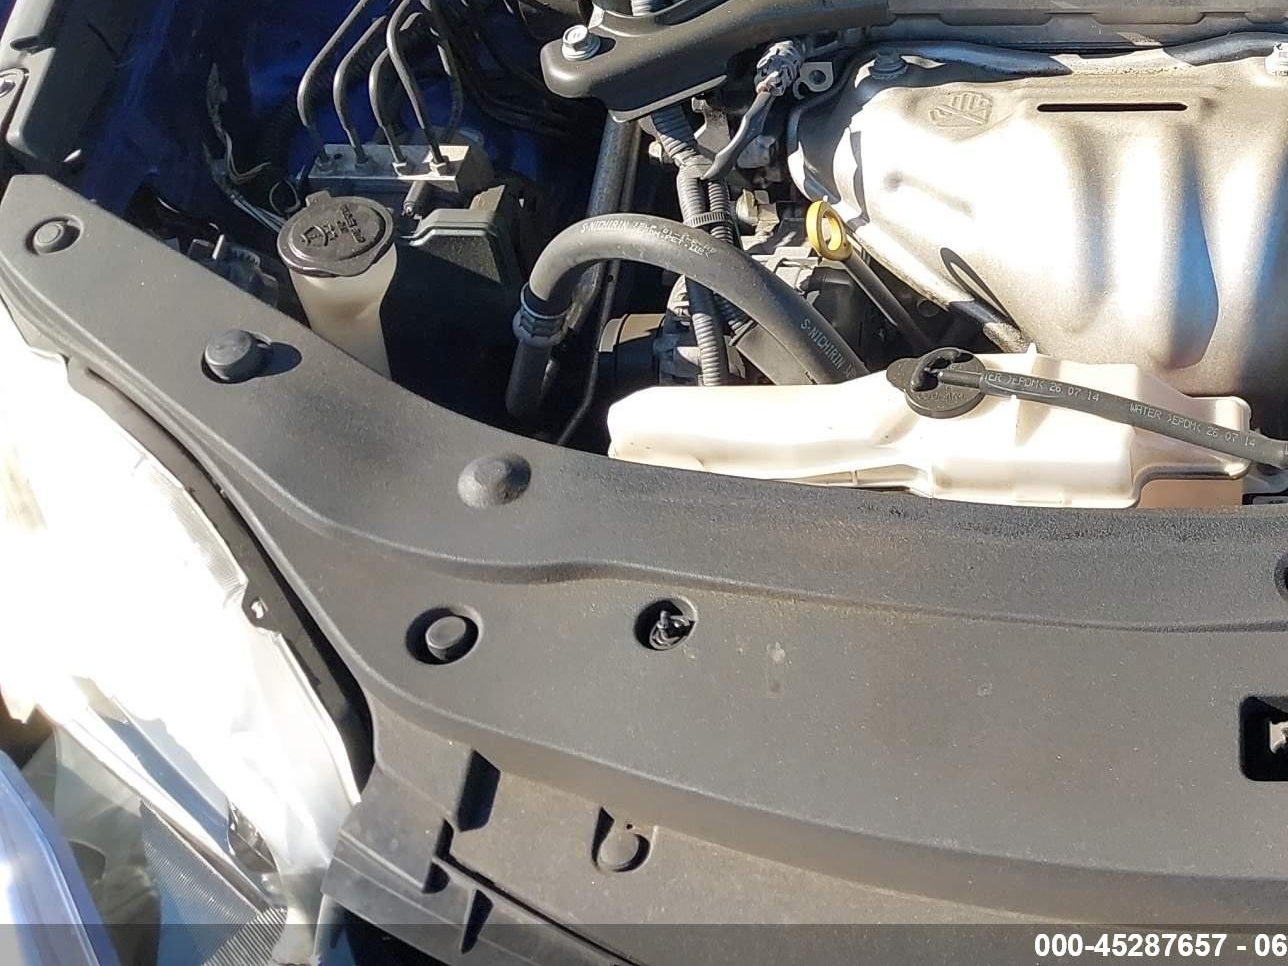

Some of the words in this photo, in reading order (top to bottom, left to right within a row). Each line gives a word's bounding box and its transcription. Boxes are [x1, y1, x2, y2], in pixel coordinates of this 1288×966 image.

[1049, 383, 1062, 394] 26
[1067, 387, 1081, 398] 07
[1087, 391, 1100, 402] 14
[1130, 403, 1163, 420] WATER
